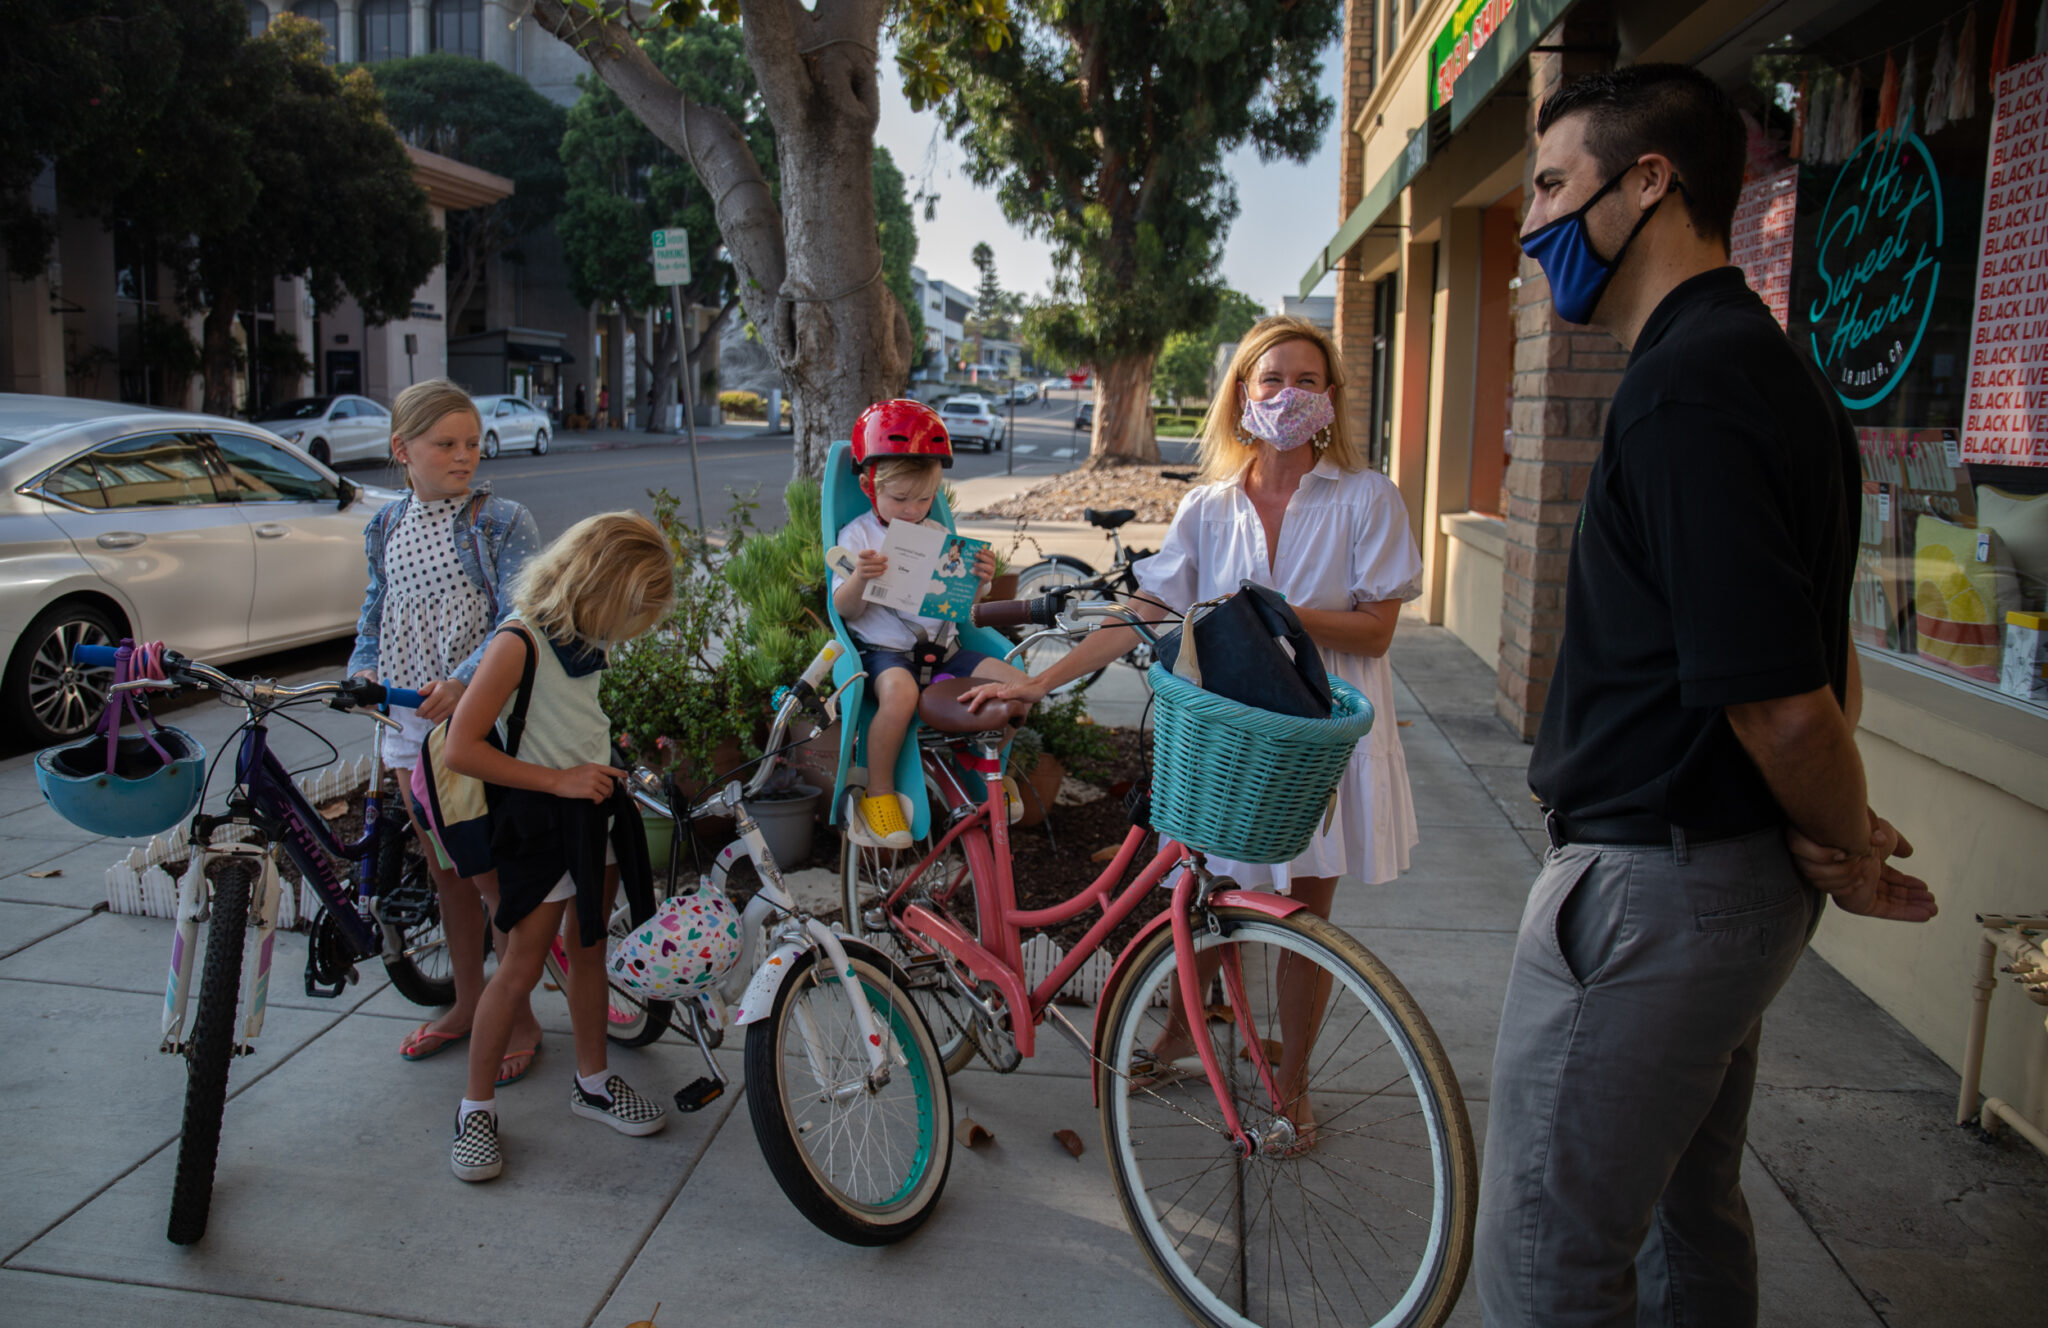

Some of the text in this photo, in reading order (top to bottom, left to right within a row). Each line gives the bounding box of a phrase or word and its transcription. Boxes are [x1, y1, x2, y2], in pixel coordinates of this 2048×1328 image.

[1999, 63, 2046, 98] BLACK
[1997, 88, 2043, 121] BLACK
[1995, 111, 2041, 144] BLACK
[1992, 136, 2038, 167] BLACK
[1859, 104, 1916, 235] Hi
[1990, 159, 2035, 189] BLACK
[1988, 182, 2034, 211] BLACK
[1986, 205, 2032, 234] BLACK
[655, 233, 664, 246] 2
[1766, 224, 1793, 241] MATTER
[1984, 229, 2029, 256] BLACK
[1764, 241, 1792, 257] MATTER
[1809, 174, 1932, 324] Sweet
[1763, 258, 1792, 273] MATTER
[1982, 253, 2027, 278] BLACK
[1762, 275, 1790, 289] MATTER
[1980, 276, 2025, 300] BLACK
[1825, 241, 1936, 368] Heart
[1977, 299, 2022, 322] BLACK
[1975, 320, 2048, 344] BLACK LIV
[1888, 340, 1904, 363] CA
[1973, 345, 2018, 366] BLACK
[1971, 368, 2016, 388] BLACK
[1968, 391, 2013, 410] BLACK
[1966, 413, 2048, 433] BLACK LIVE
[1963, 436, 2008, 454] BLACK
